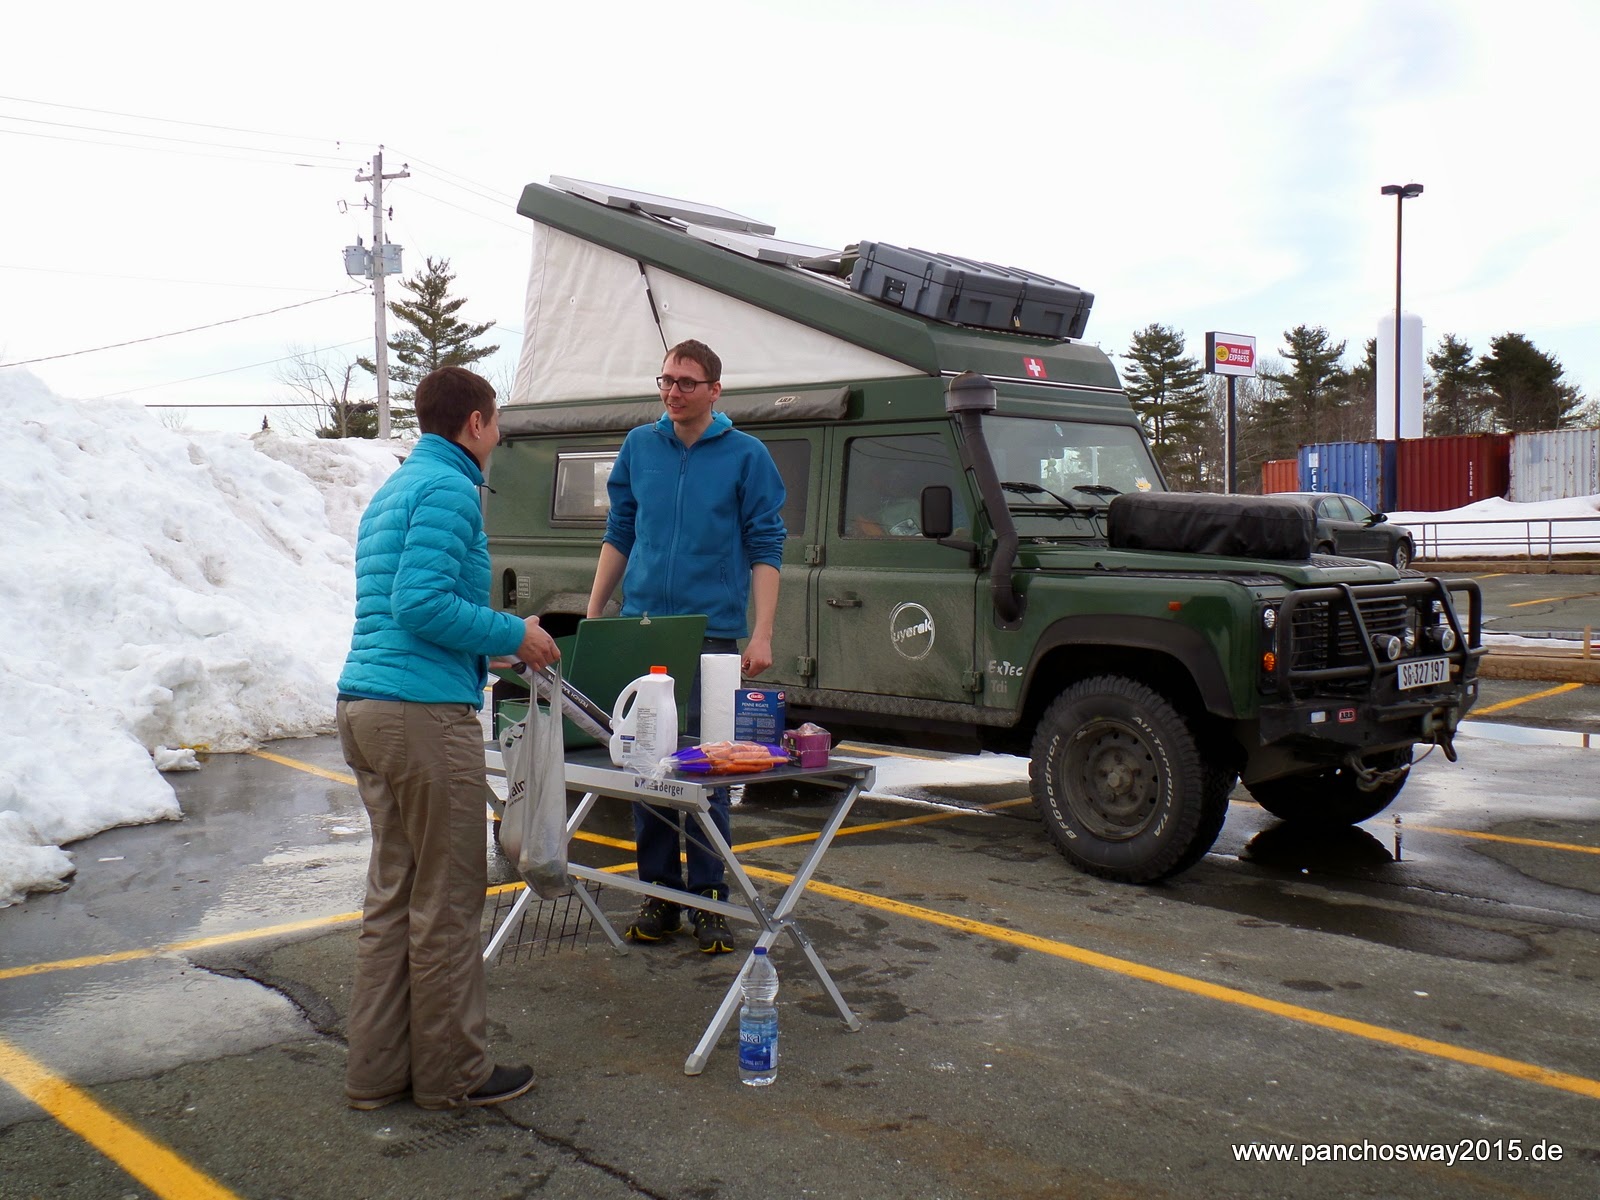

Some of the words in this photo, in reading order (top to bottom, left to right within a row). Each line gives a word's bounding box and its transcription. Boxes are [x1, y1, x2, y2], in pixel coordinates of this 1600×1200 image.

[1229, 353, 1250, 363] EXPRESS
[991, 680, 1008, 694] Tdi
[742, 1033, 760, 1043] ska
